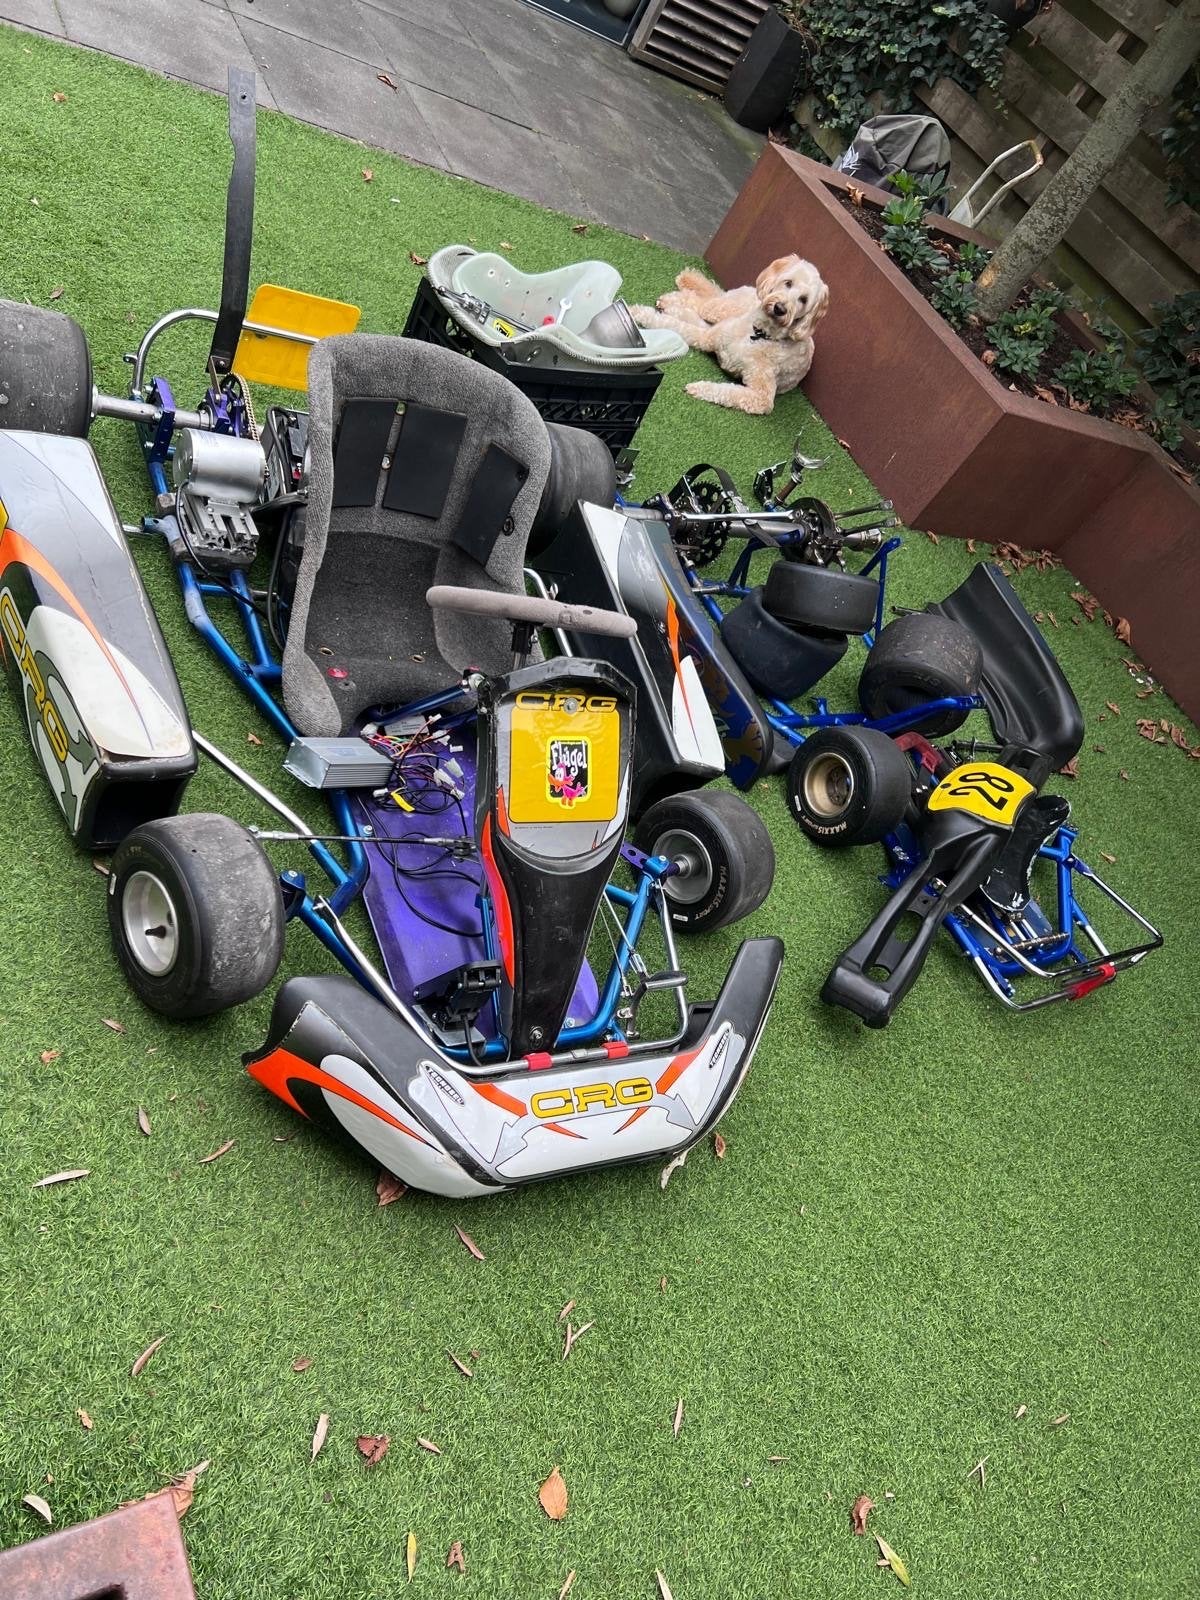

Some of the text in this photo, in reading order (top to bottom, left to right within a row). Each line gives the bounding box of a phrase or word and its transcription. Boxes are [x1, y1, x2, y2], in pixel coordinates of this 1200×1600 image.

[1, 593, 69, 763] CRG
[515, 692, 618, 713] CRG
[817, 821, 847, 834] MAXXIS
[531, 1077, 653, 1118] CRG
